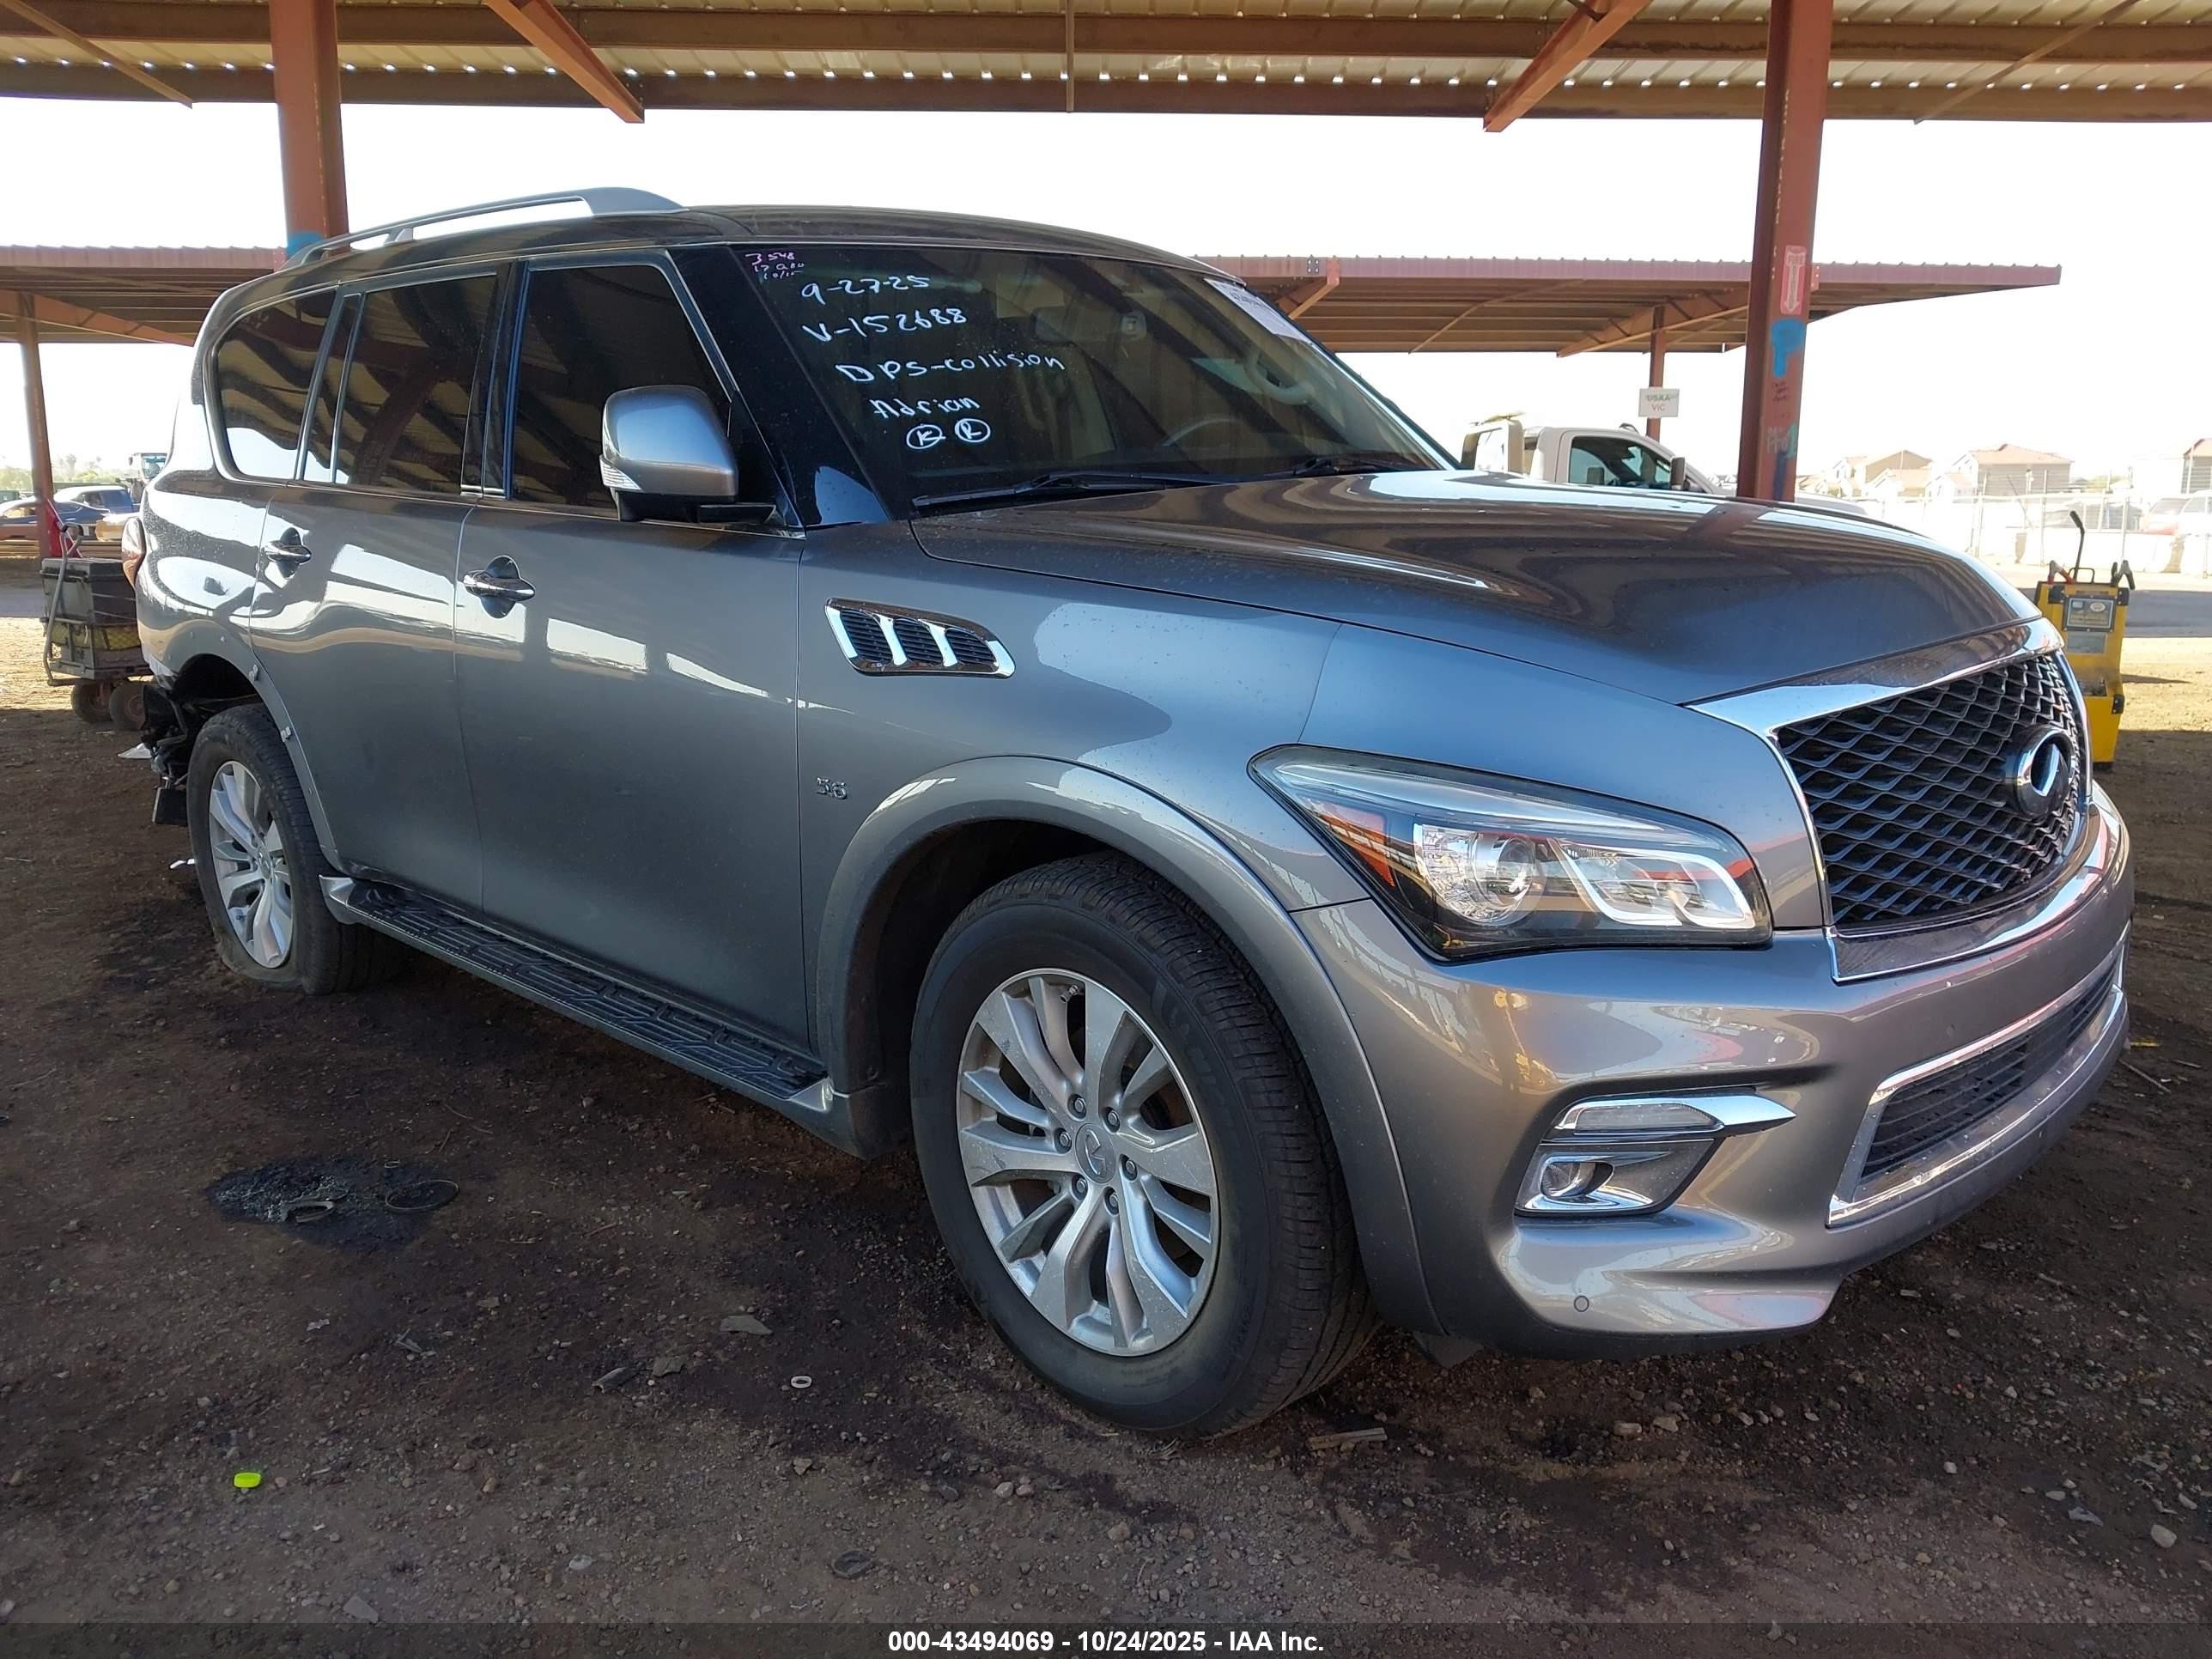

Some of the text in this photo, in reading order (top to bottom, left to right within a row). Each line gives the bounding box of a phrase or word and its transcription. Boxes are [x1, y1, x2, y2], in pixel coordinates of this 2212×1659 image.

[801, 275, 930, 305] 9-27-25
[802, 307, 968, 343] V-152688
[869, 397, 980, 419] Adrian
